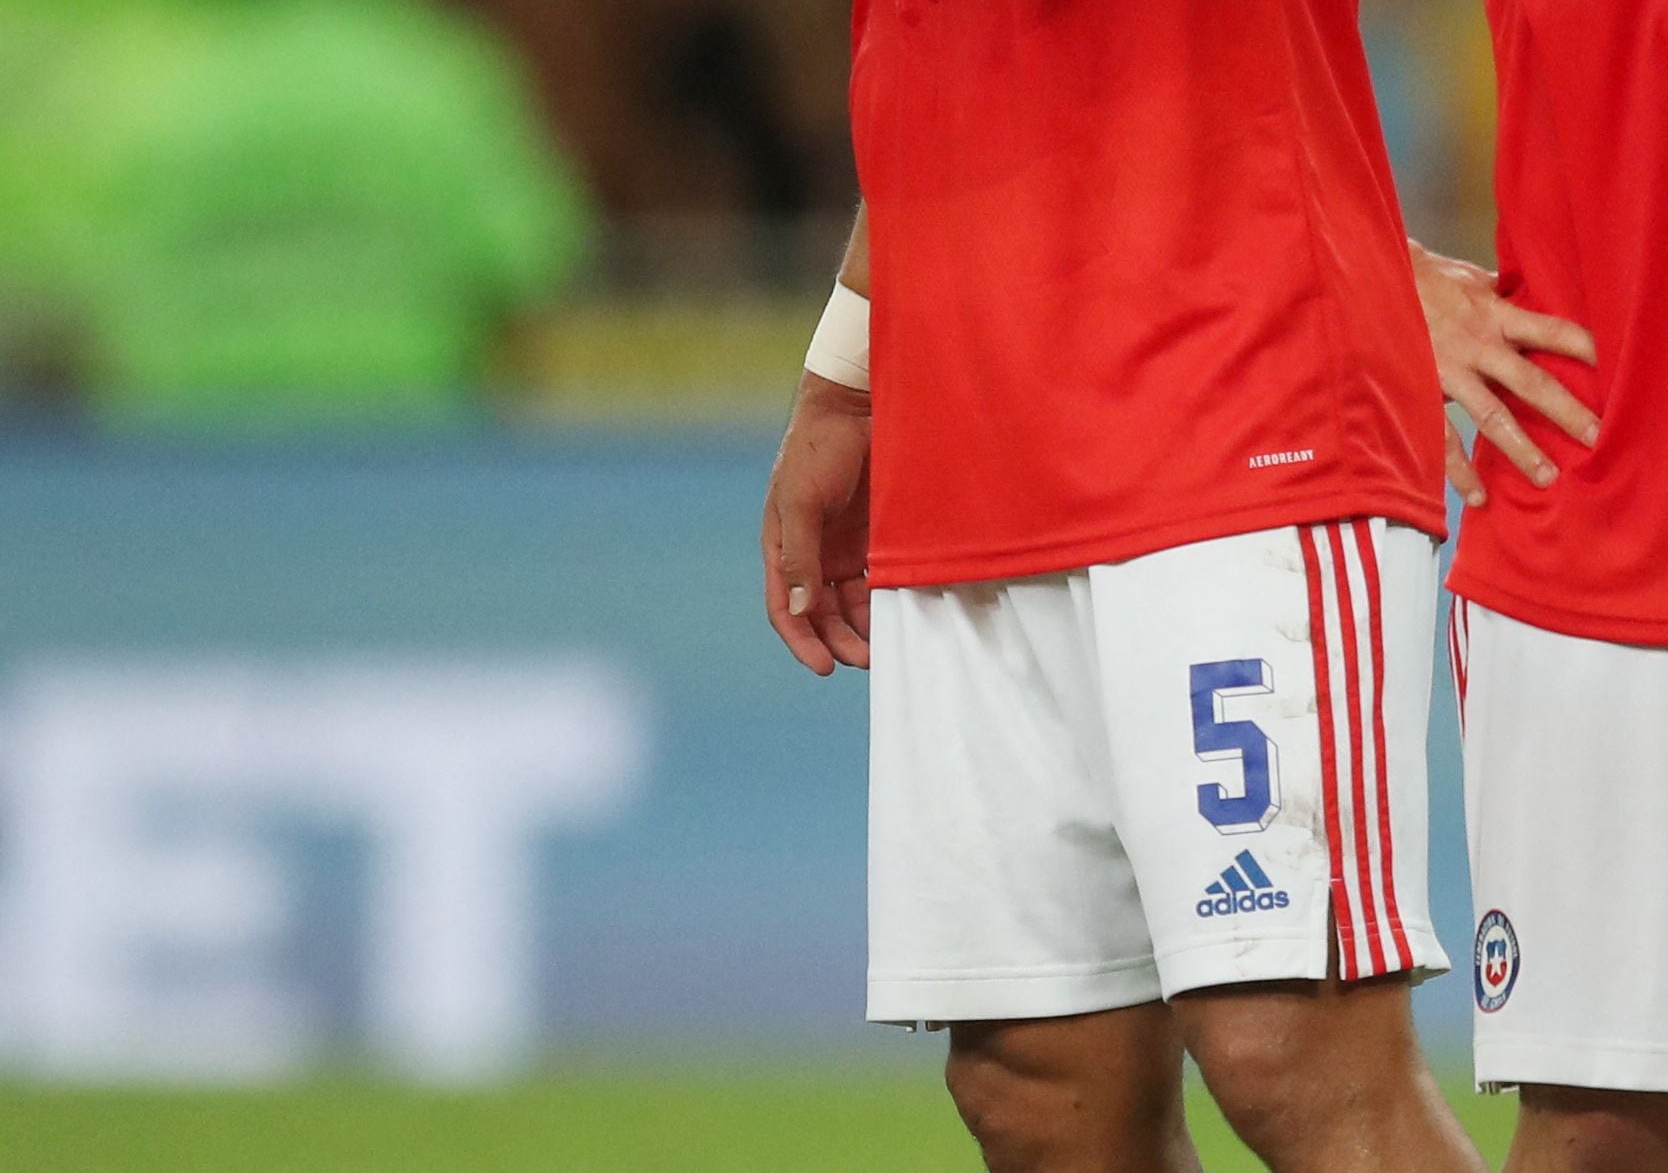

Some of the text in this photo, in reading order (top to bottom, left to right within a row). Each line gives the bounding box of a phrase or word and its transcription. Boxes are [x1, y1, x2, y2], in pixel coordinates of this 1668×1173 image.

[1249, 449, 1314, 469] AEROREADY
[1190, 658, 1282, 835] 5
[1196, 889, 1290, 918] adidas
